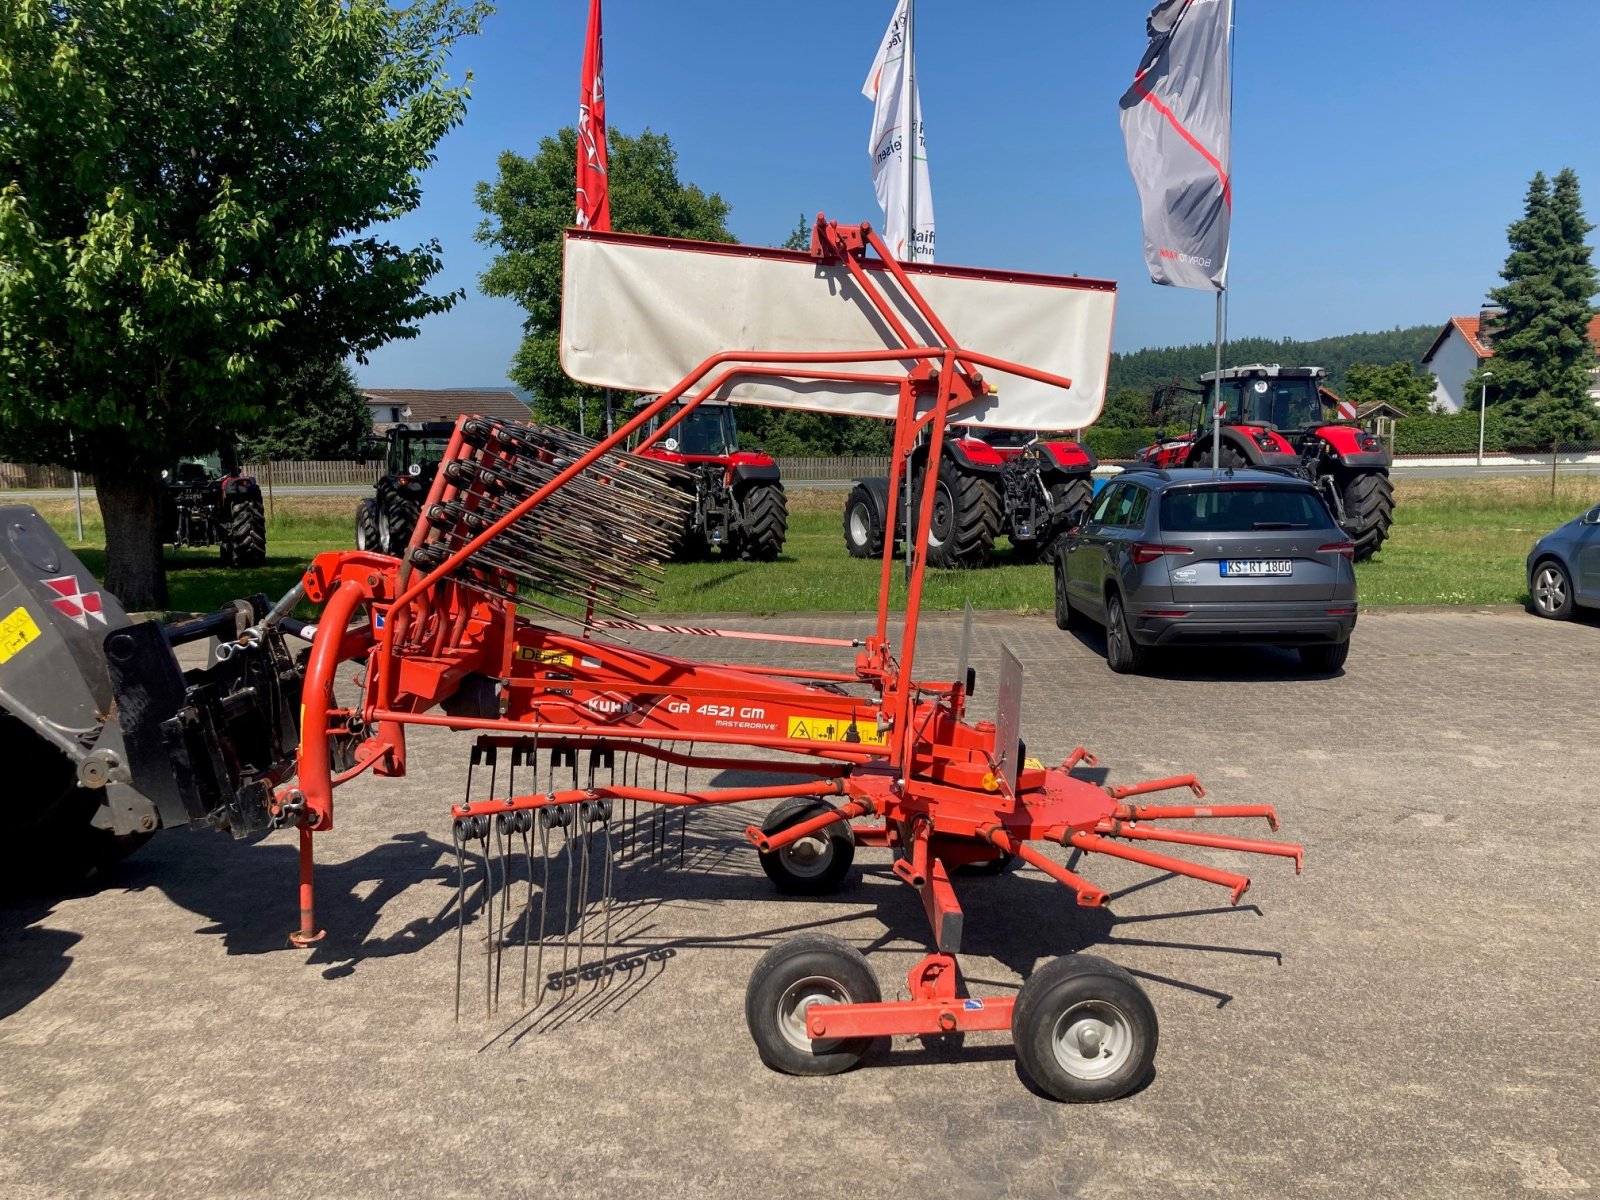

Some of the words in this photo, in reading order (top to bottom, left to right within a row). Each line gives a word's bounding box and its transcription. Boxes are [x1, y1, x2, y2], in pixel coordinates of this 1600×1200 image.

[1228, 561, 1242, 573] KS
[1249, 561, 1263, 573] RT
[1266, 561, 1291, 573] 1800
[588, 700, 633, 713] KUHN
[668, 702, 690, 714] GA
[696, 704, 735, 718] 4521
[740, 707, 765, 720] GM
